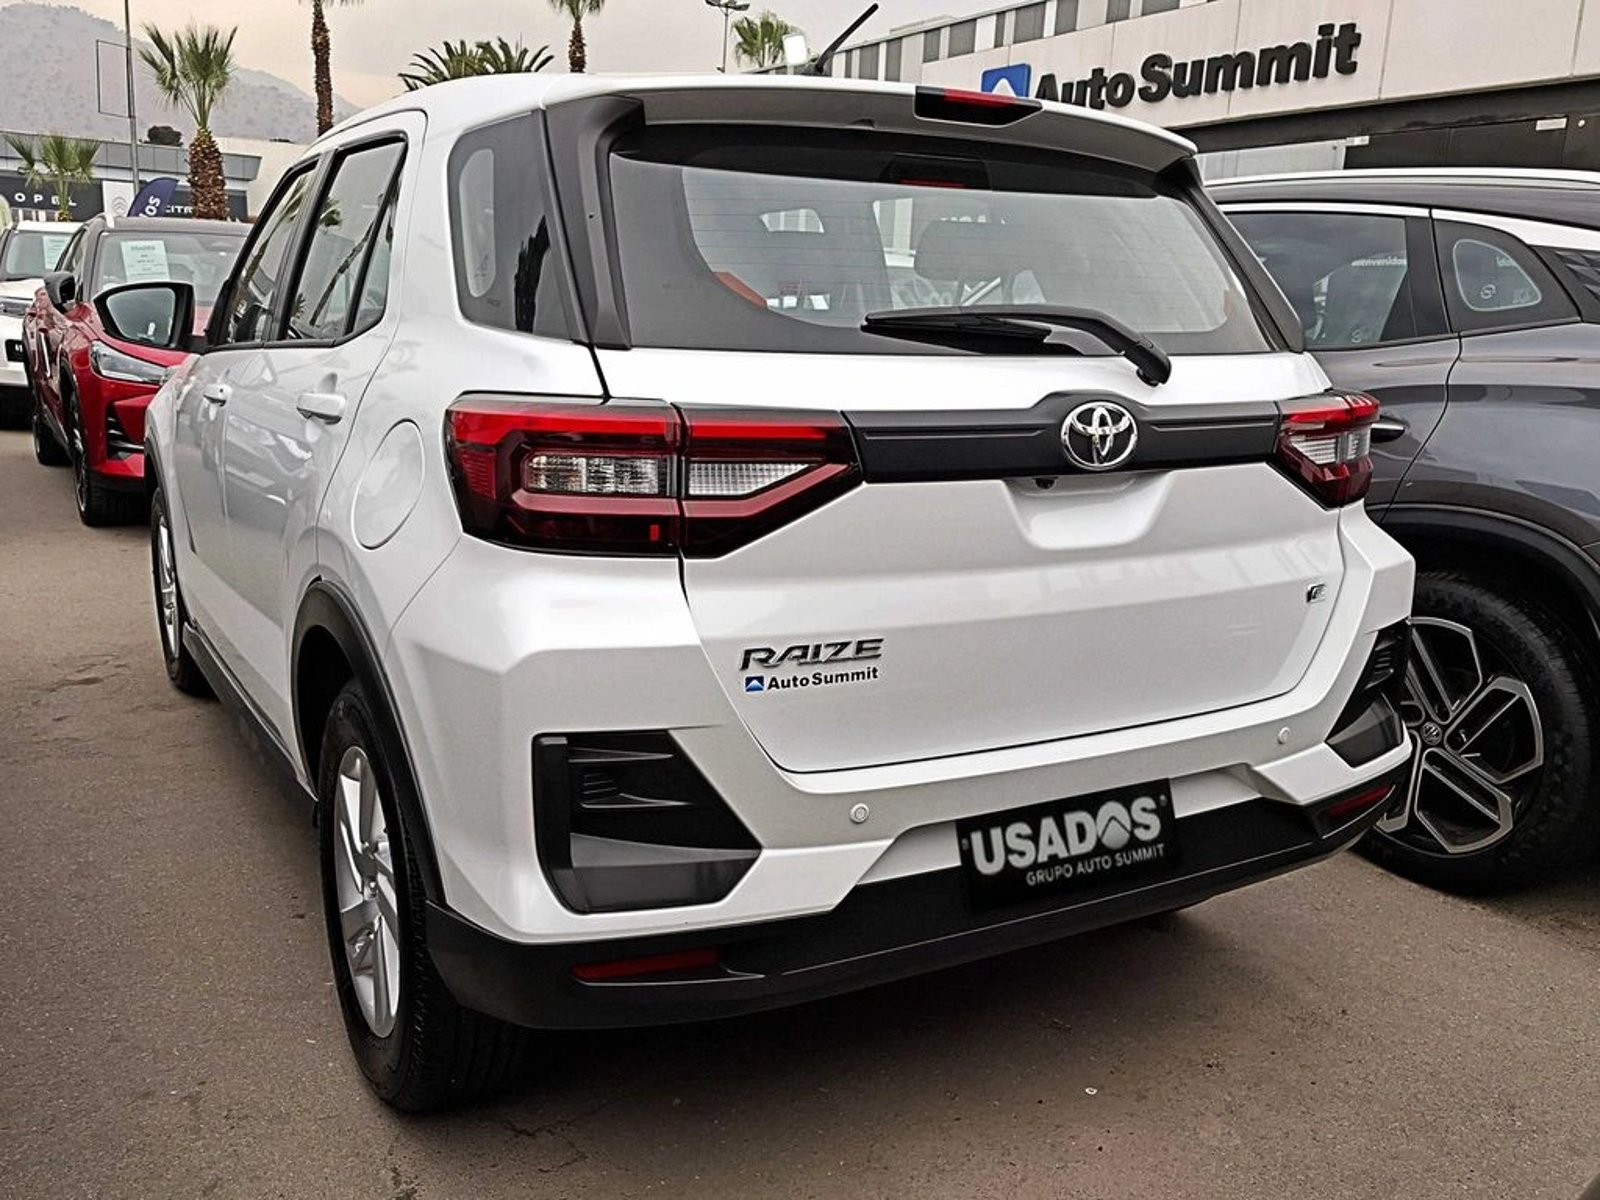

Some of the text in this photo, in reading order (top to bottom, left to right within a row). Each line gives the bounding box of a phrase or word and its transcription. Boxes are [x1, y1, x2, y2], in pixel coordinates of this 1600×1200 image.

[739, 638, 885, 671] RAIZE
[970, 796, 1162, 876] USADOS
[1026, 843, 1165, 886] GRUPO AUTO SUMMIT
